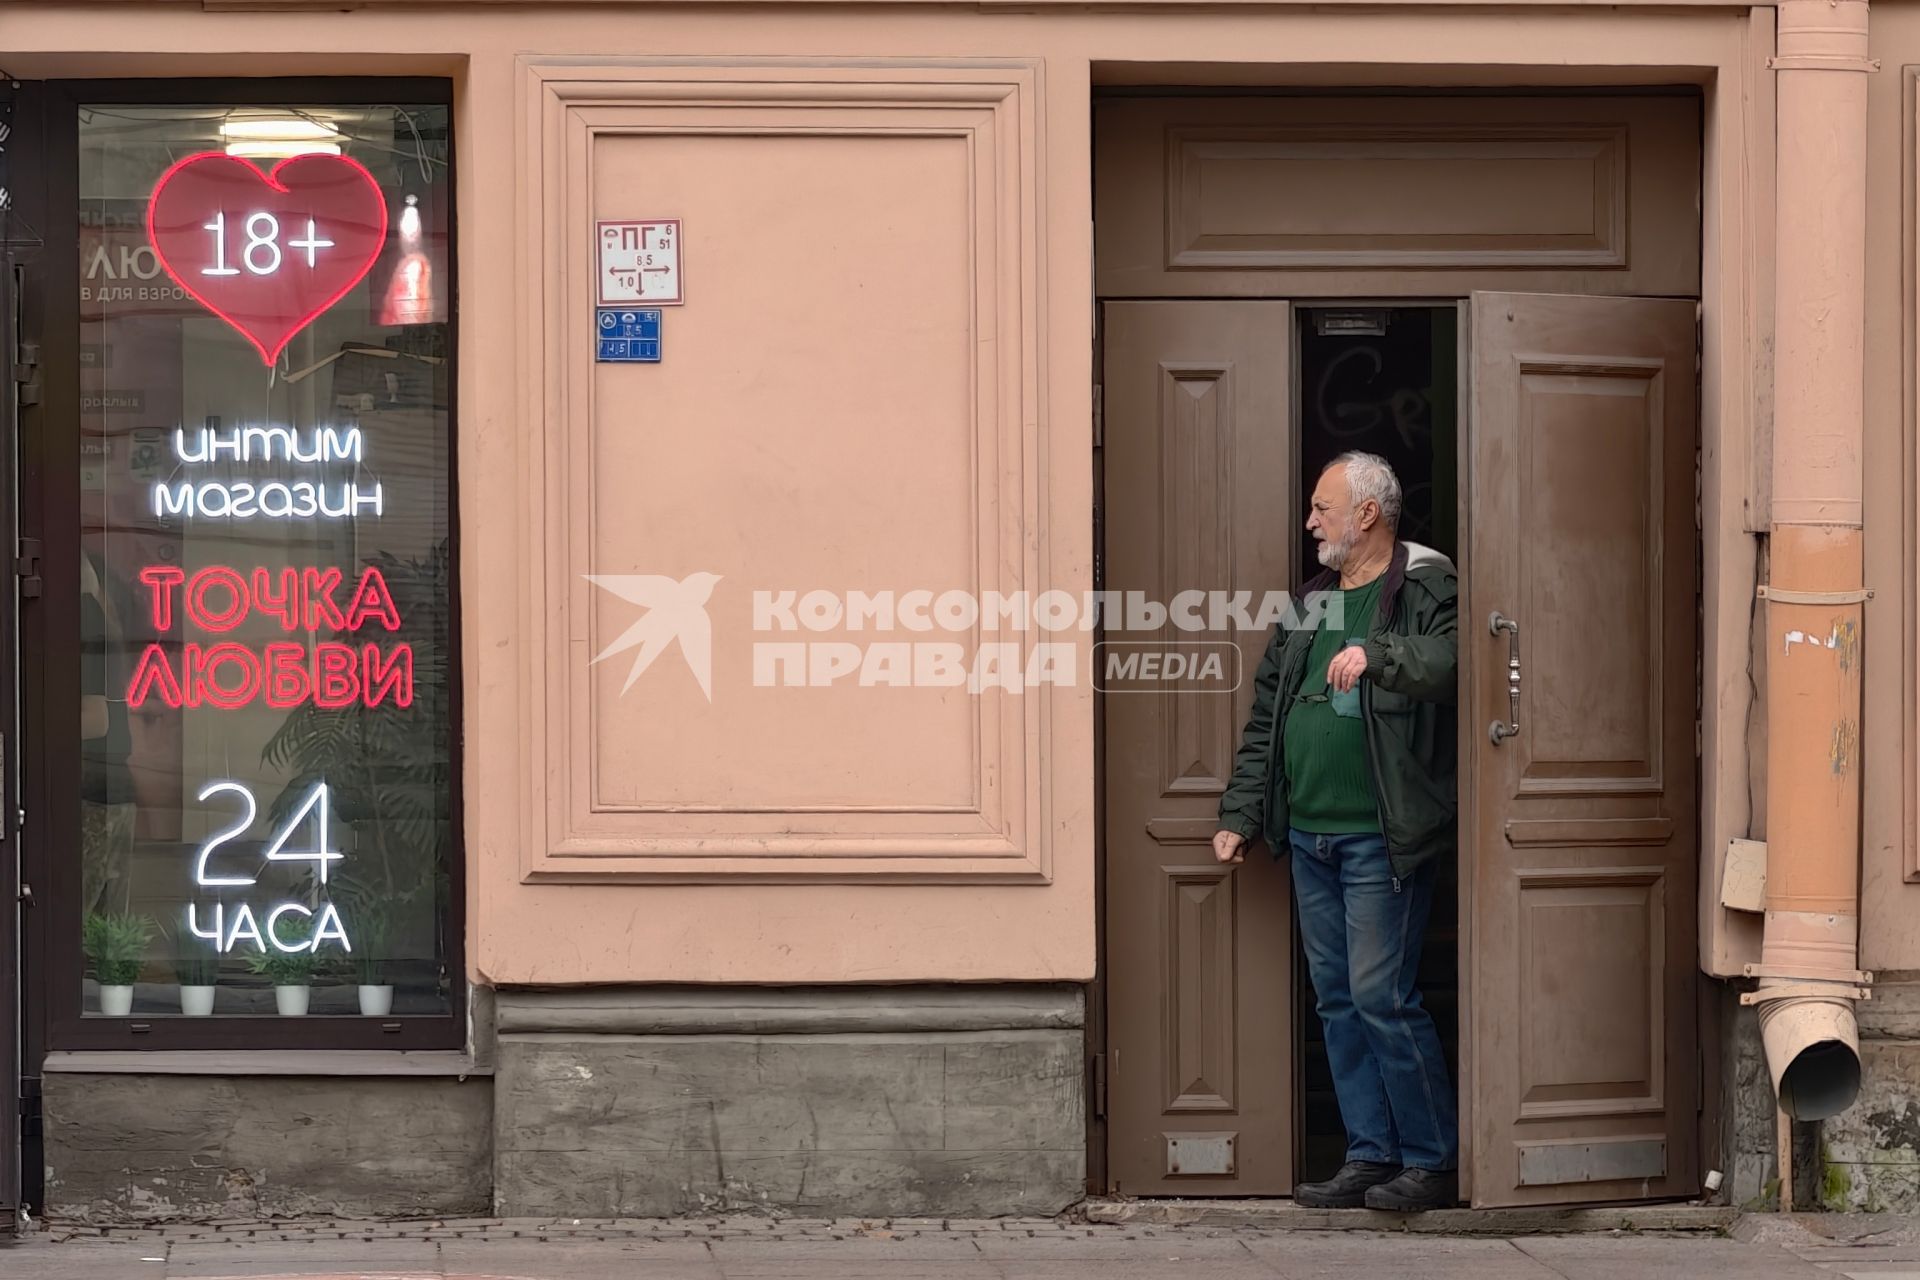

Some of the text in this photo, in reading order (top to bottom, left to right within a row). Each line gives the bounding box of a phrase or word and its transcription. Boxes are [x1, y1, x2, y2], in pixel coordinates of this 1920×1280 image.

[201, 211, 335, 276] 18+
[622, 227, 656, 250] ПГ
[659, 238, 671, 250] 51
[665, 225, 672, 235] 6
[86, 245, 170, 280] ЛЮ
[97, 287, 133, 302] ДЛЯ
[140, 565, 401, 632] ТОЧКА
[126, 643, 414, 708] ЛЮБВИ
[196, 782, 345, 886] 24
[189, 903, 351, 953] ЧАСА
